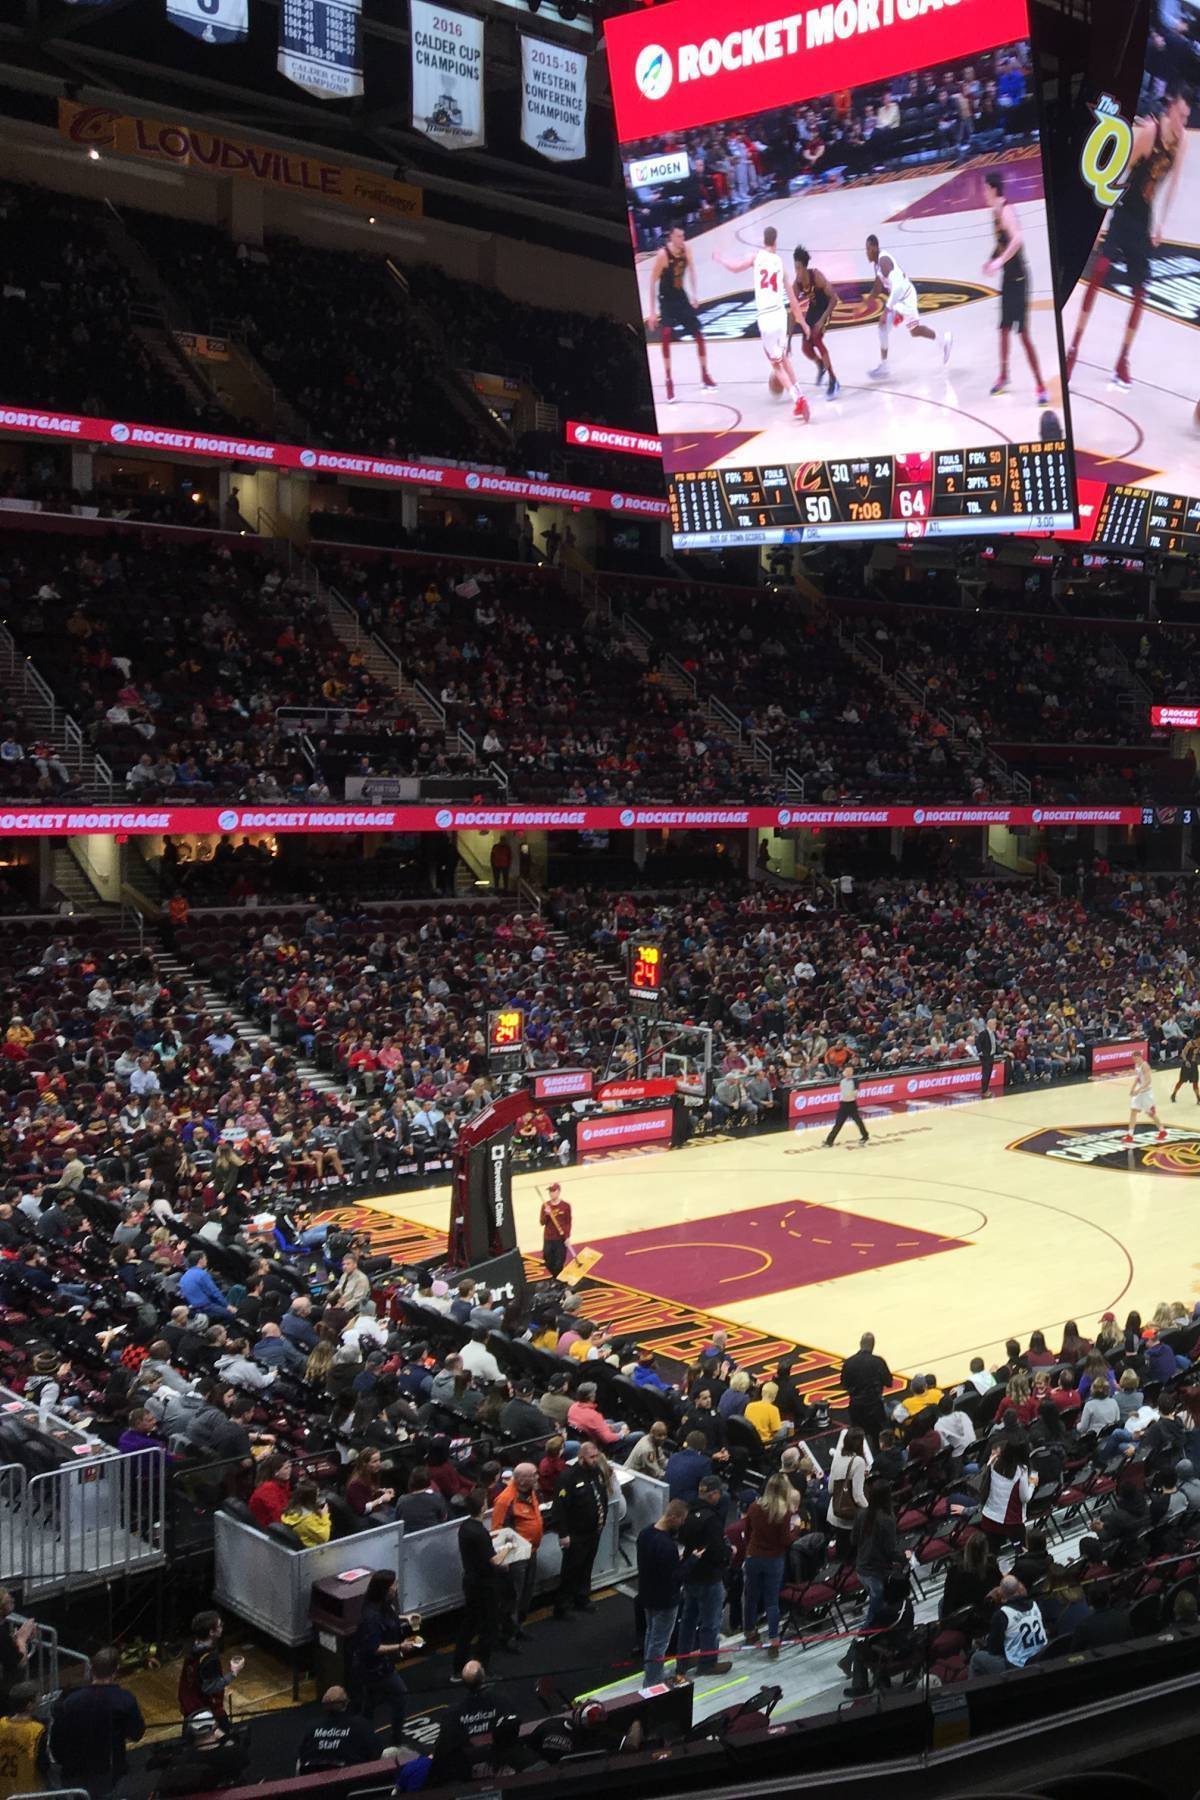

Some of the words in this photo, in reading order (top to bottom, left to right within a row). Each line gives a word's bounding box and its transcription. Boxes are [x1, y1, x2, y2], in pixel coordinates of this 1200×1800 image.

[433, 16, 462, 37] 2016
[415, 31, 456, 57] CALDER
[459, 45, 481, 62] CUP
[678, 14, 803, 83] ROCKET
[416, 50, 480, 81] CHAMPIONS
[531, 50, 577, 74] 2015-16
[292, 72, 349, 93] CHAMPIONS
[330, 71, 350, 84] CUP
[533, 69, 577, 93] WESTERN
[525, 83, 583, 111] CONFERENCE
[1097, 94, 1120, 115] The
[528, 100, 581, 127] CHAMPIONS
[136, 119, 344, 196] LOUDVILLE
[1082, 111, 1131, 206] Q
[650, 161, 681, 177] MOEN
[760, 269, 778, 292] 24
[132, 429, 193, 450] ROCKET
[194, 436, 274, 459] MORTGAGE
[591, 430, 637, 449] ROCKET
[939, 454, 960, 465] FOULS
[968, 451, 986, 464] FG%
[989, 451, 1001, 463] 50
[318, 453, 374, 474] ROCKET
[374, 461, 443, 483] MORTGAGE
[764, 468, 784, 479] FOULS
[831, 463, 850, 484] 3Q
[874, 463, 891, 478] 24
[946, 477, 956, 492] 2
[966, 476, 988, 490] 3PT%
[989, 474, 1001, 487] 53
[481, 478, 529, 495] ROCKET
[529, 483, 591, 503] MORTGAGE
[775, 489, 781, 503] 1
[624, 497, 667, 514] ROCKET
[805, 496, 832, 523] 50
[848, 502, 882, 521] 7:08
[899, 490, 925, 517] 64
[966, 501, 983, 514] TOL
[990, 499, 998, 513] 4
[1036, 516, 1055, 528] 3:00
[1167, 709, 1199, 717] ROCKET
[0, 814, 66, 829] OCKET
[66, 813, 171, 828] MORTGAGE
[240, 813, 307, 827] ROCKET
[307, 812, 396, 826] MORTGAGE
[455, 812, 511, 825] ROCKET
[511, 811, 586, 824] MORTGAGE
[636, 812, 683, 825] ROCKET
[683, 811, 749, 824] MORTGAGE
[791, 811, 832, 824] ROCKET
[832, 811, 888, 823] MORTGAGE
[926, 811, 961, 822] ROCKET
[961, 811, 1010, 822] MORTGAGE
[1042, 811, 1072, 821] ROCKET
[1072, 811, 1121, 821] MORTGAGE
[1183, 810, 1191, 823] 3
[633, 961, 655, 986] 24
[496, 1026, 514, 1042] 24
[549, 1074, 585, 1085] ROCKET
[918, 1076, 953, 1090] ROCKET
[951, 1069, 997, 1086] MORTGE
[545, 1083, 586, 1095] MORTGAGE
[806, 1092, 841, 1106] ROCKE
[592, 1126, 622, 1138] ROCKET
[621, 1119, 666, 1134] MORTGAGE
[494, 1160, 503, 1202] Cleveland
[495, 1202, 505, 1228] Clinic
[1020, 1619, 1046, 1649] 22
[459, 1708, 497, 1724] Medical
[314, 1727, 351, 1738] Medical
[468, 1722, 489, 1735] Staff
[318, 1740, 341, 1750] Staff
